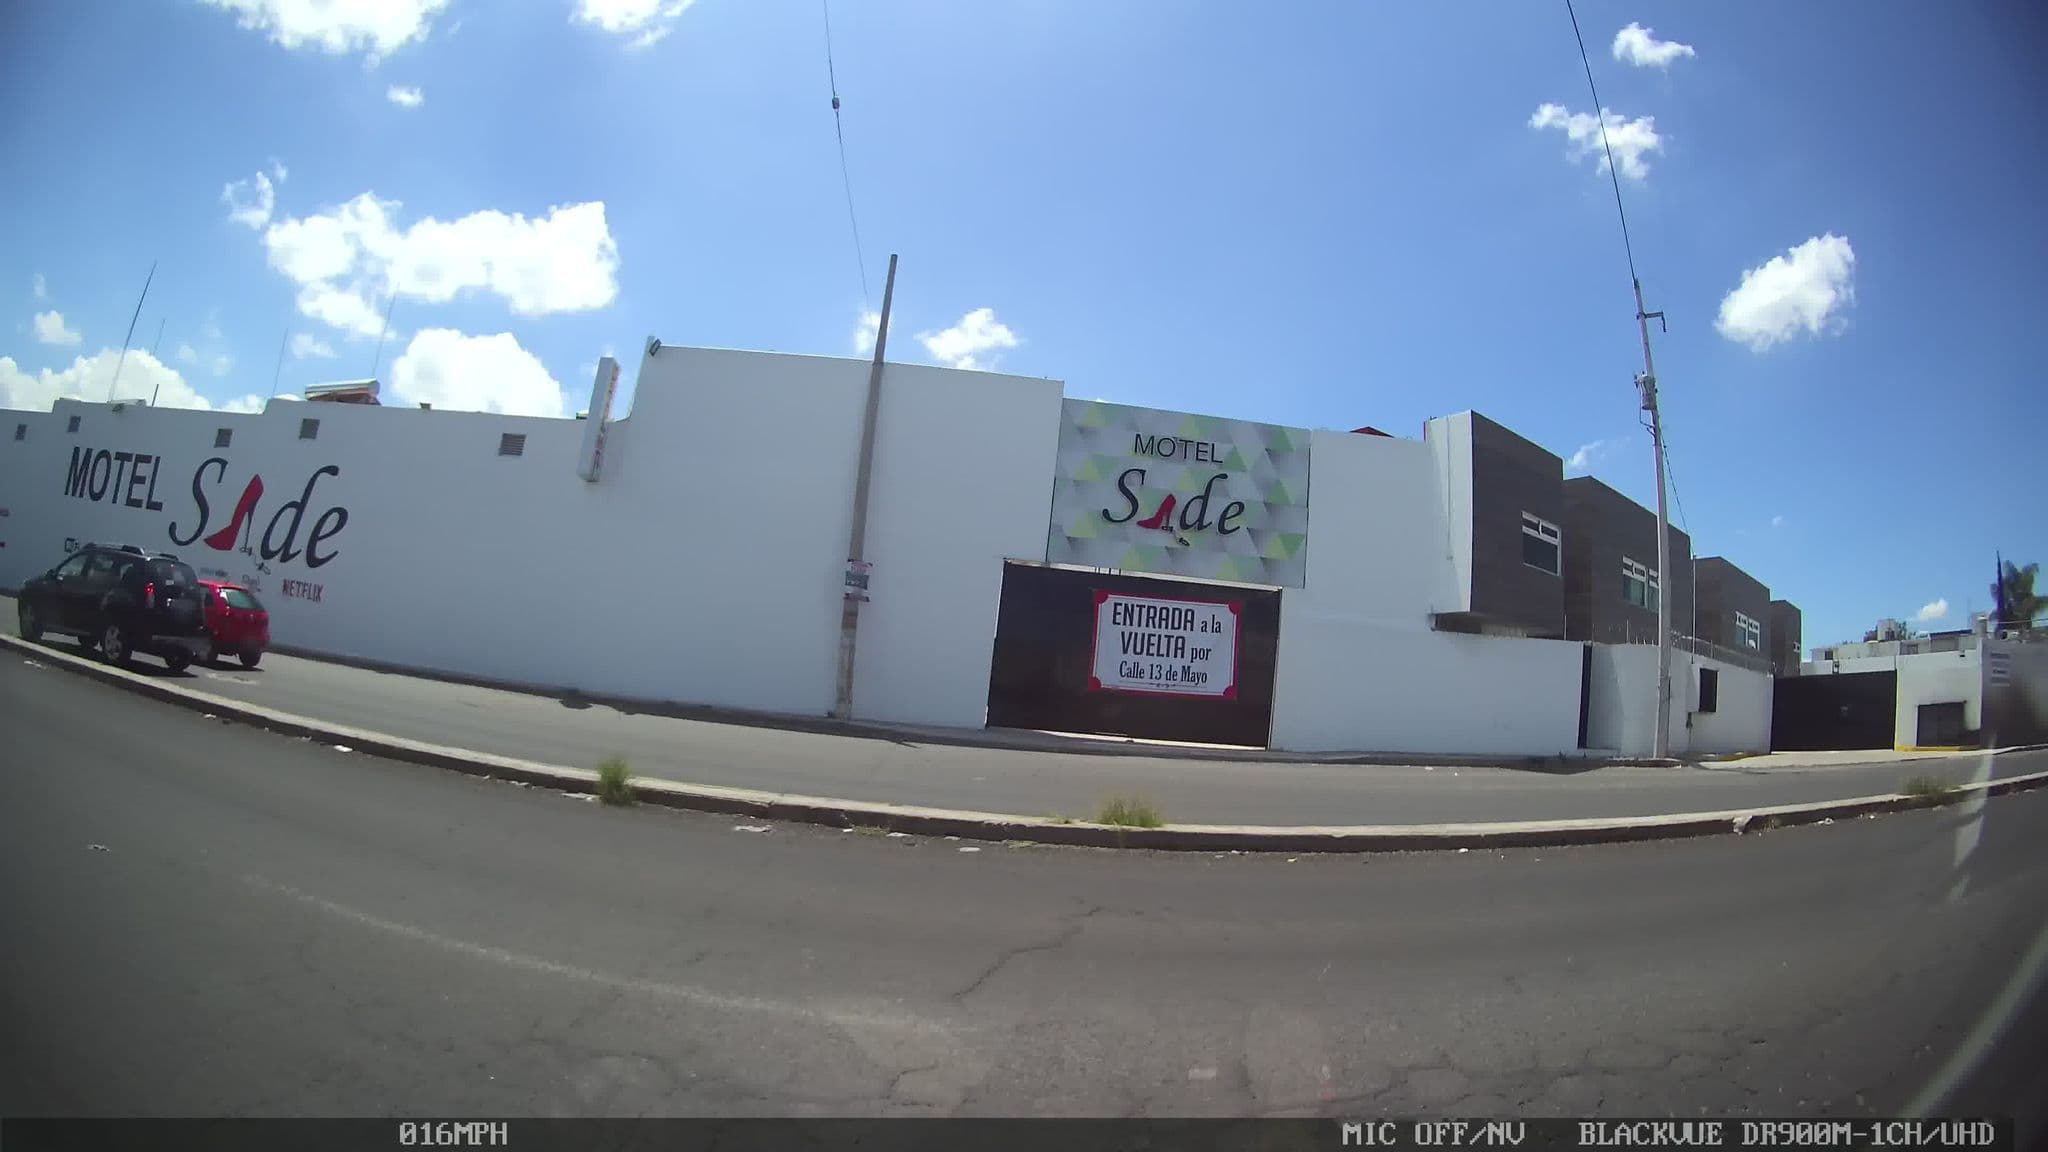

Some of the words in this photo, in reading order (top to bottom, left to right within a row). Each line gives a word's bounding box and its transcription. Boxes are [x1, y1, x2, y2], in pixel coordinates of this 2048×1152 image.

[1134, 433, 1224, 464] MOTEL
[64, 446, 164, 512] MOTEL
[282, 578, 324, 603] NETFLIX
[1112, 602, 1195, 632] ENTRADA
[1200, 619, 1208, 633] a
[1211, 614, 1222, 634] la
[1121, 631, 1186, 659] VUELTA
[1190, 646, 1212, 663] por
[1119, 660, 1145, 679] Calle
[1149, 663, 1162, 681] 13
[1165, 664, 1178, 681] de
[1181, 666, 1208, 686] Mayo
